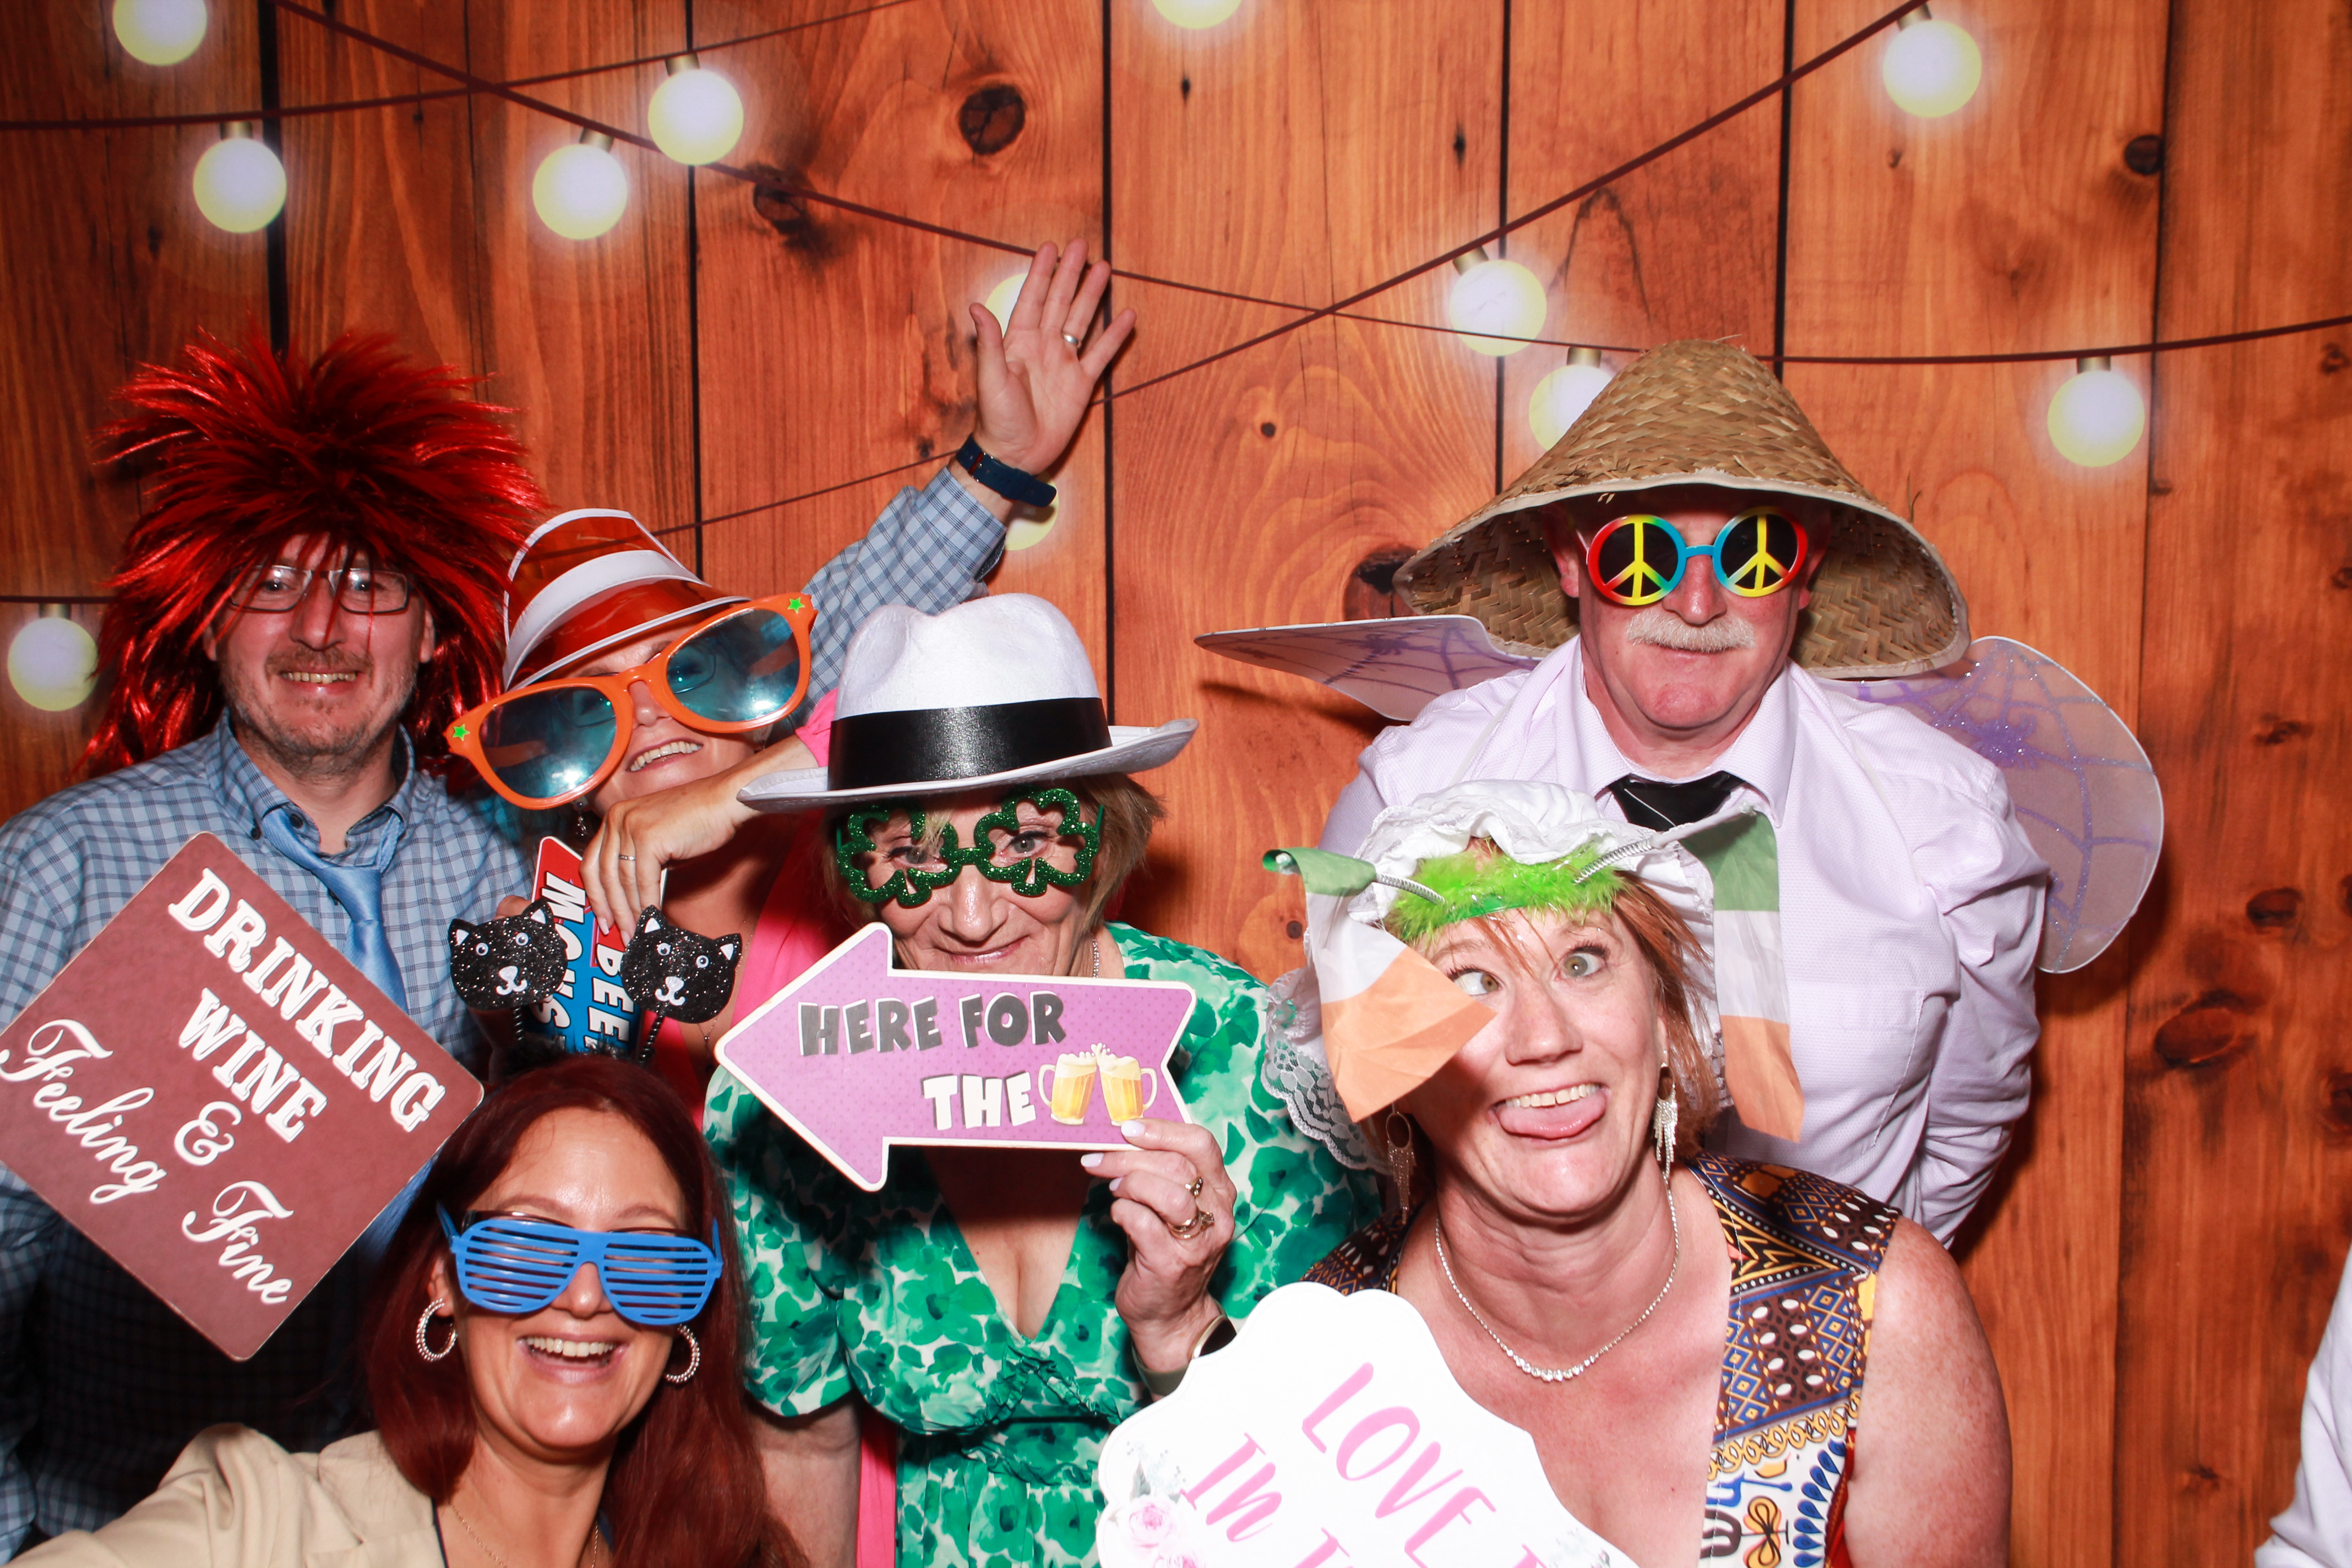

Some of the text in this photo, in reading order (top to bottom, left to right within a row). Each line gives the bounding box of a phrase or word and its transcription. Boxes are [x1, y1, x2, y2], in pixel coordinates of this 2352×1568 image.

[167, 867, 447, 1133] DRINKING
[584, 943, 634, 1048] BEE
[798, 990, 1066, 1056] HERE FOR
[178, 987, 328, 1143] WINE
[921, 1071, 1038, 1131] THE
[0, 1019, 295, 1304] Feeling Fine
[173, 1101, 242, 1166] &
[1302, 1362, 1496, 1568] LOVE
